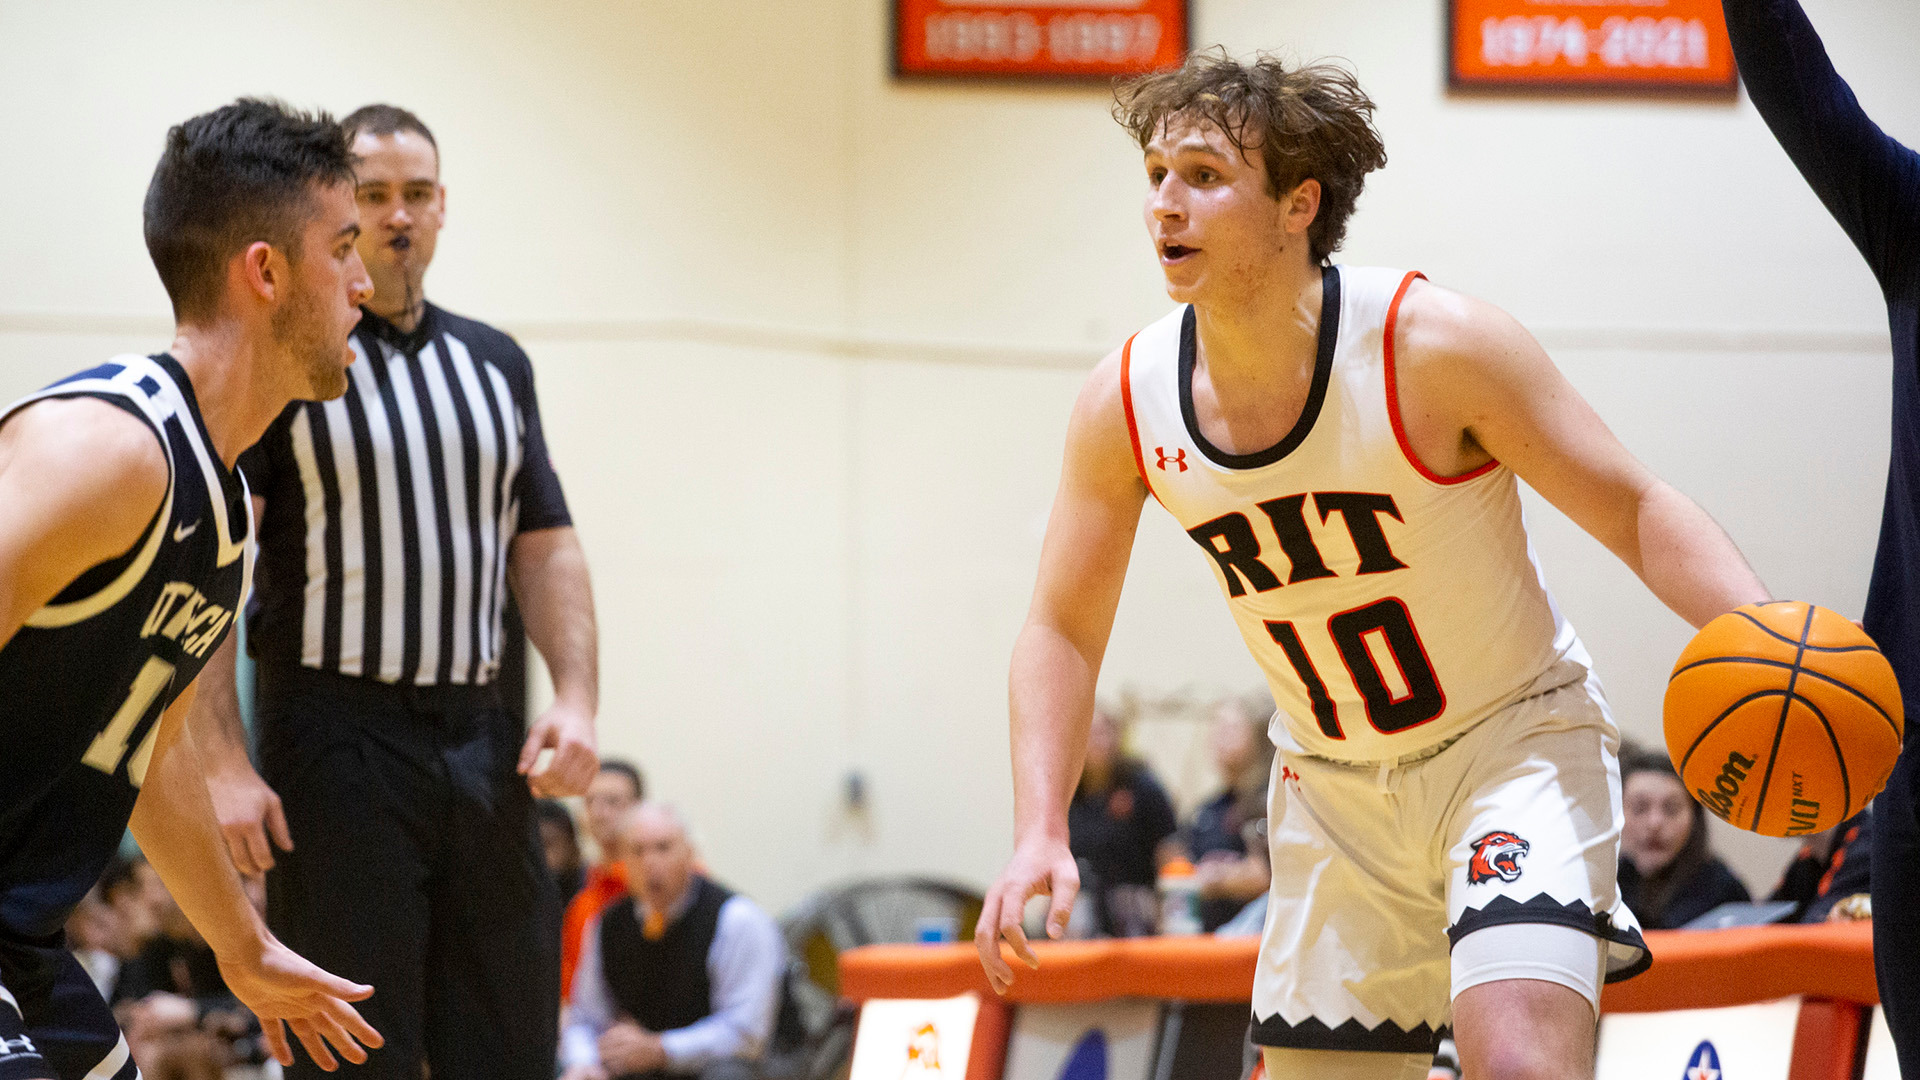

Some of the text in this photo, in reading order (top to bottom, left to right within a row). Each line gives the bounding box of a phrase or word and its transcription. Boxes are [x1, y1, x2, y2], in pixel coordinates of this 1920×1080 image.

[1185, 491, 1411, 599] RIT
[140, 581, 233, 659] ITCA
[1262, 596, 1448, 741] 10
[1697, 751, 1756, 821] lson
[1784, 798, 1820, 837] VO
